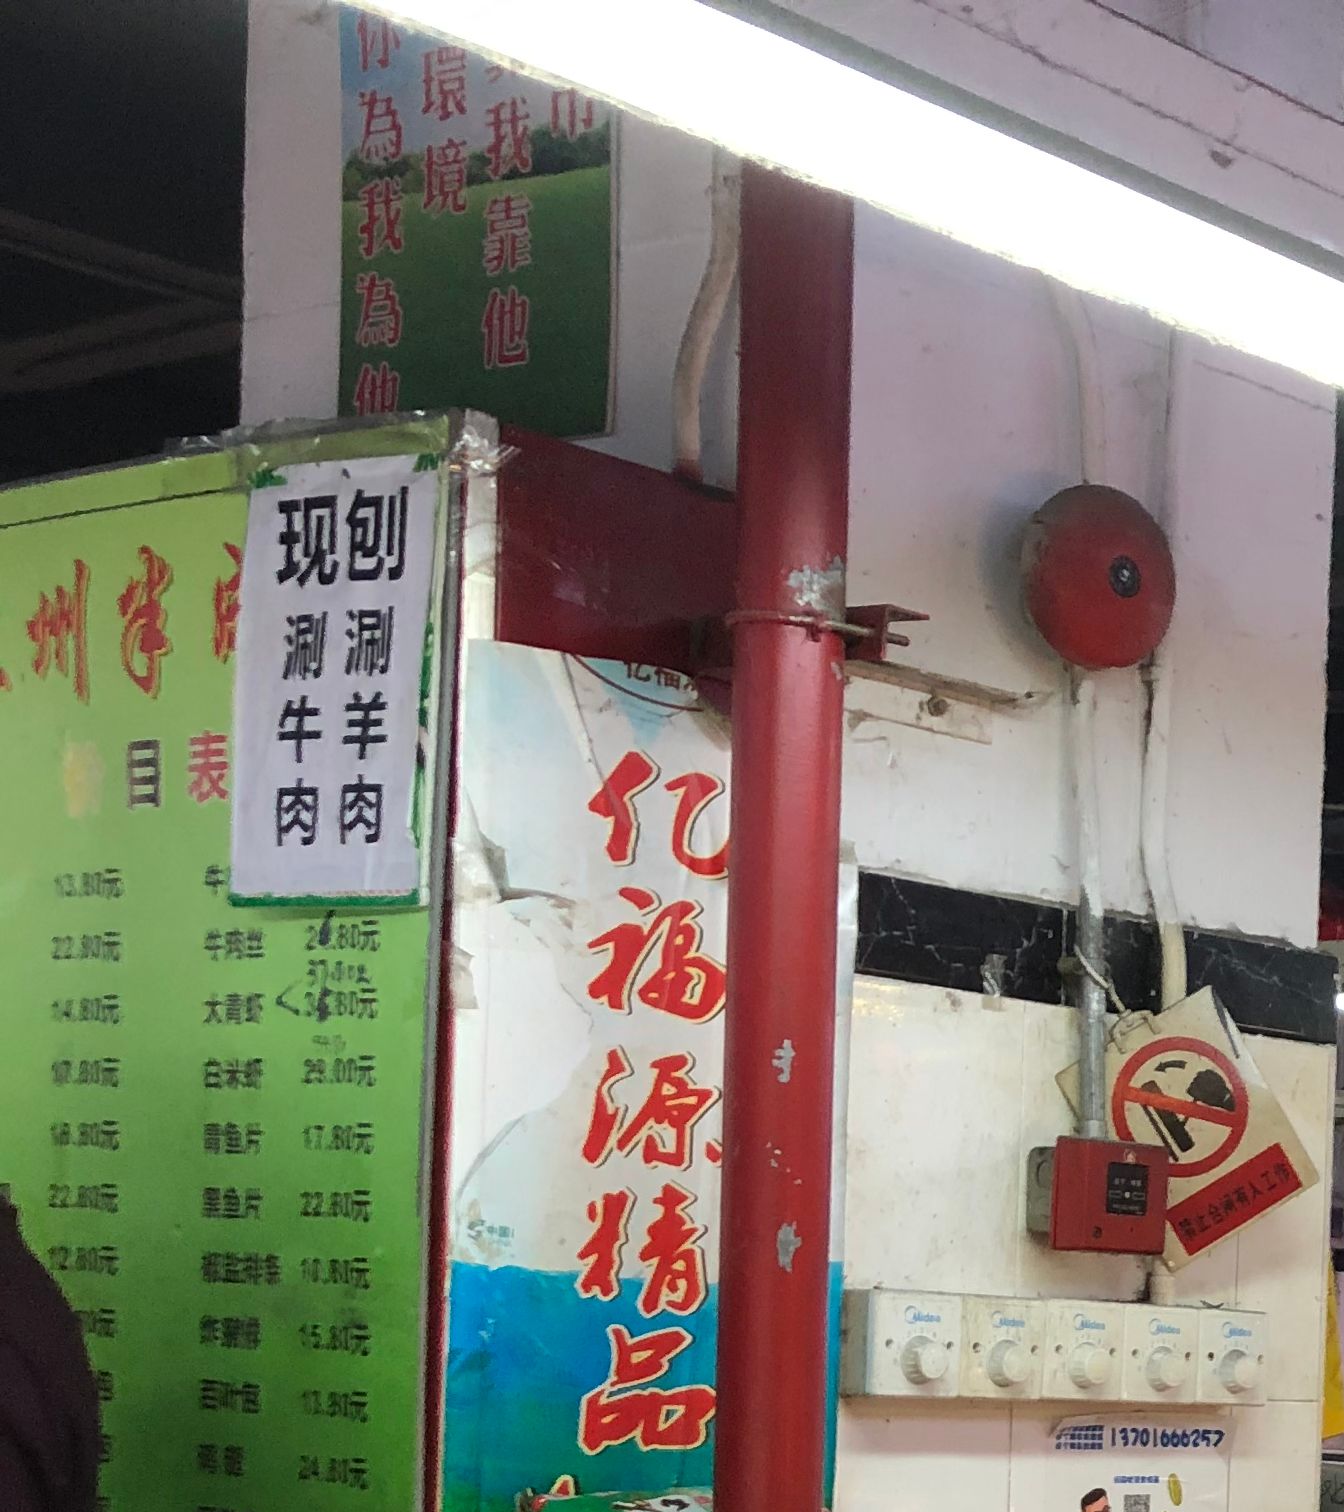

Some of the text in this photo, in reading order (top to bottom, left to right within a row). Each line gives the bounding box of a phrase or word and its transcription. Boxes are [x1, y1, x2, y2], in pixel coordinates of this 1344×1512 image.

[483, 72, 531, 369] 我靠他
[276, 485, 409, 588] 现刨
[276, 611, 328, 847] 涮牛肉
[339, 605, 395, 844] 涮羊肉
[575, 749, 730, 1458] 亿福源精品
